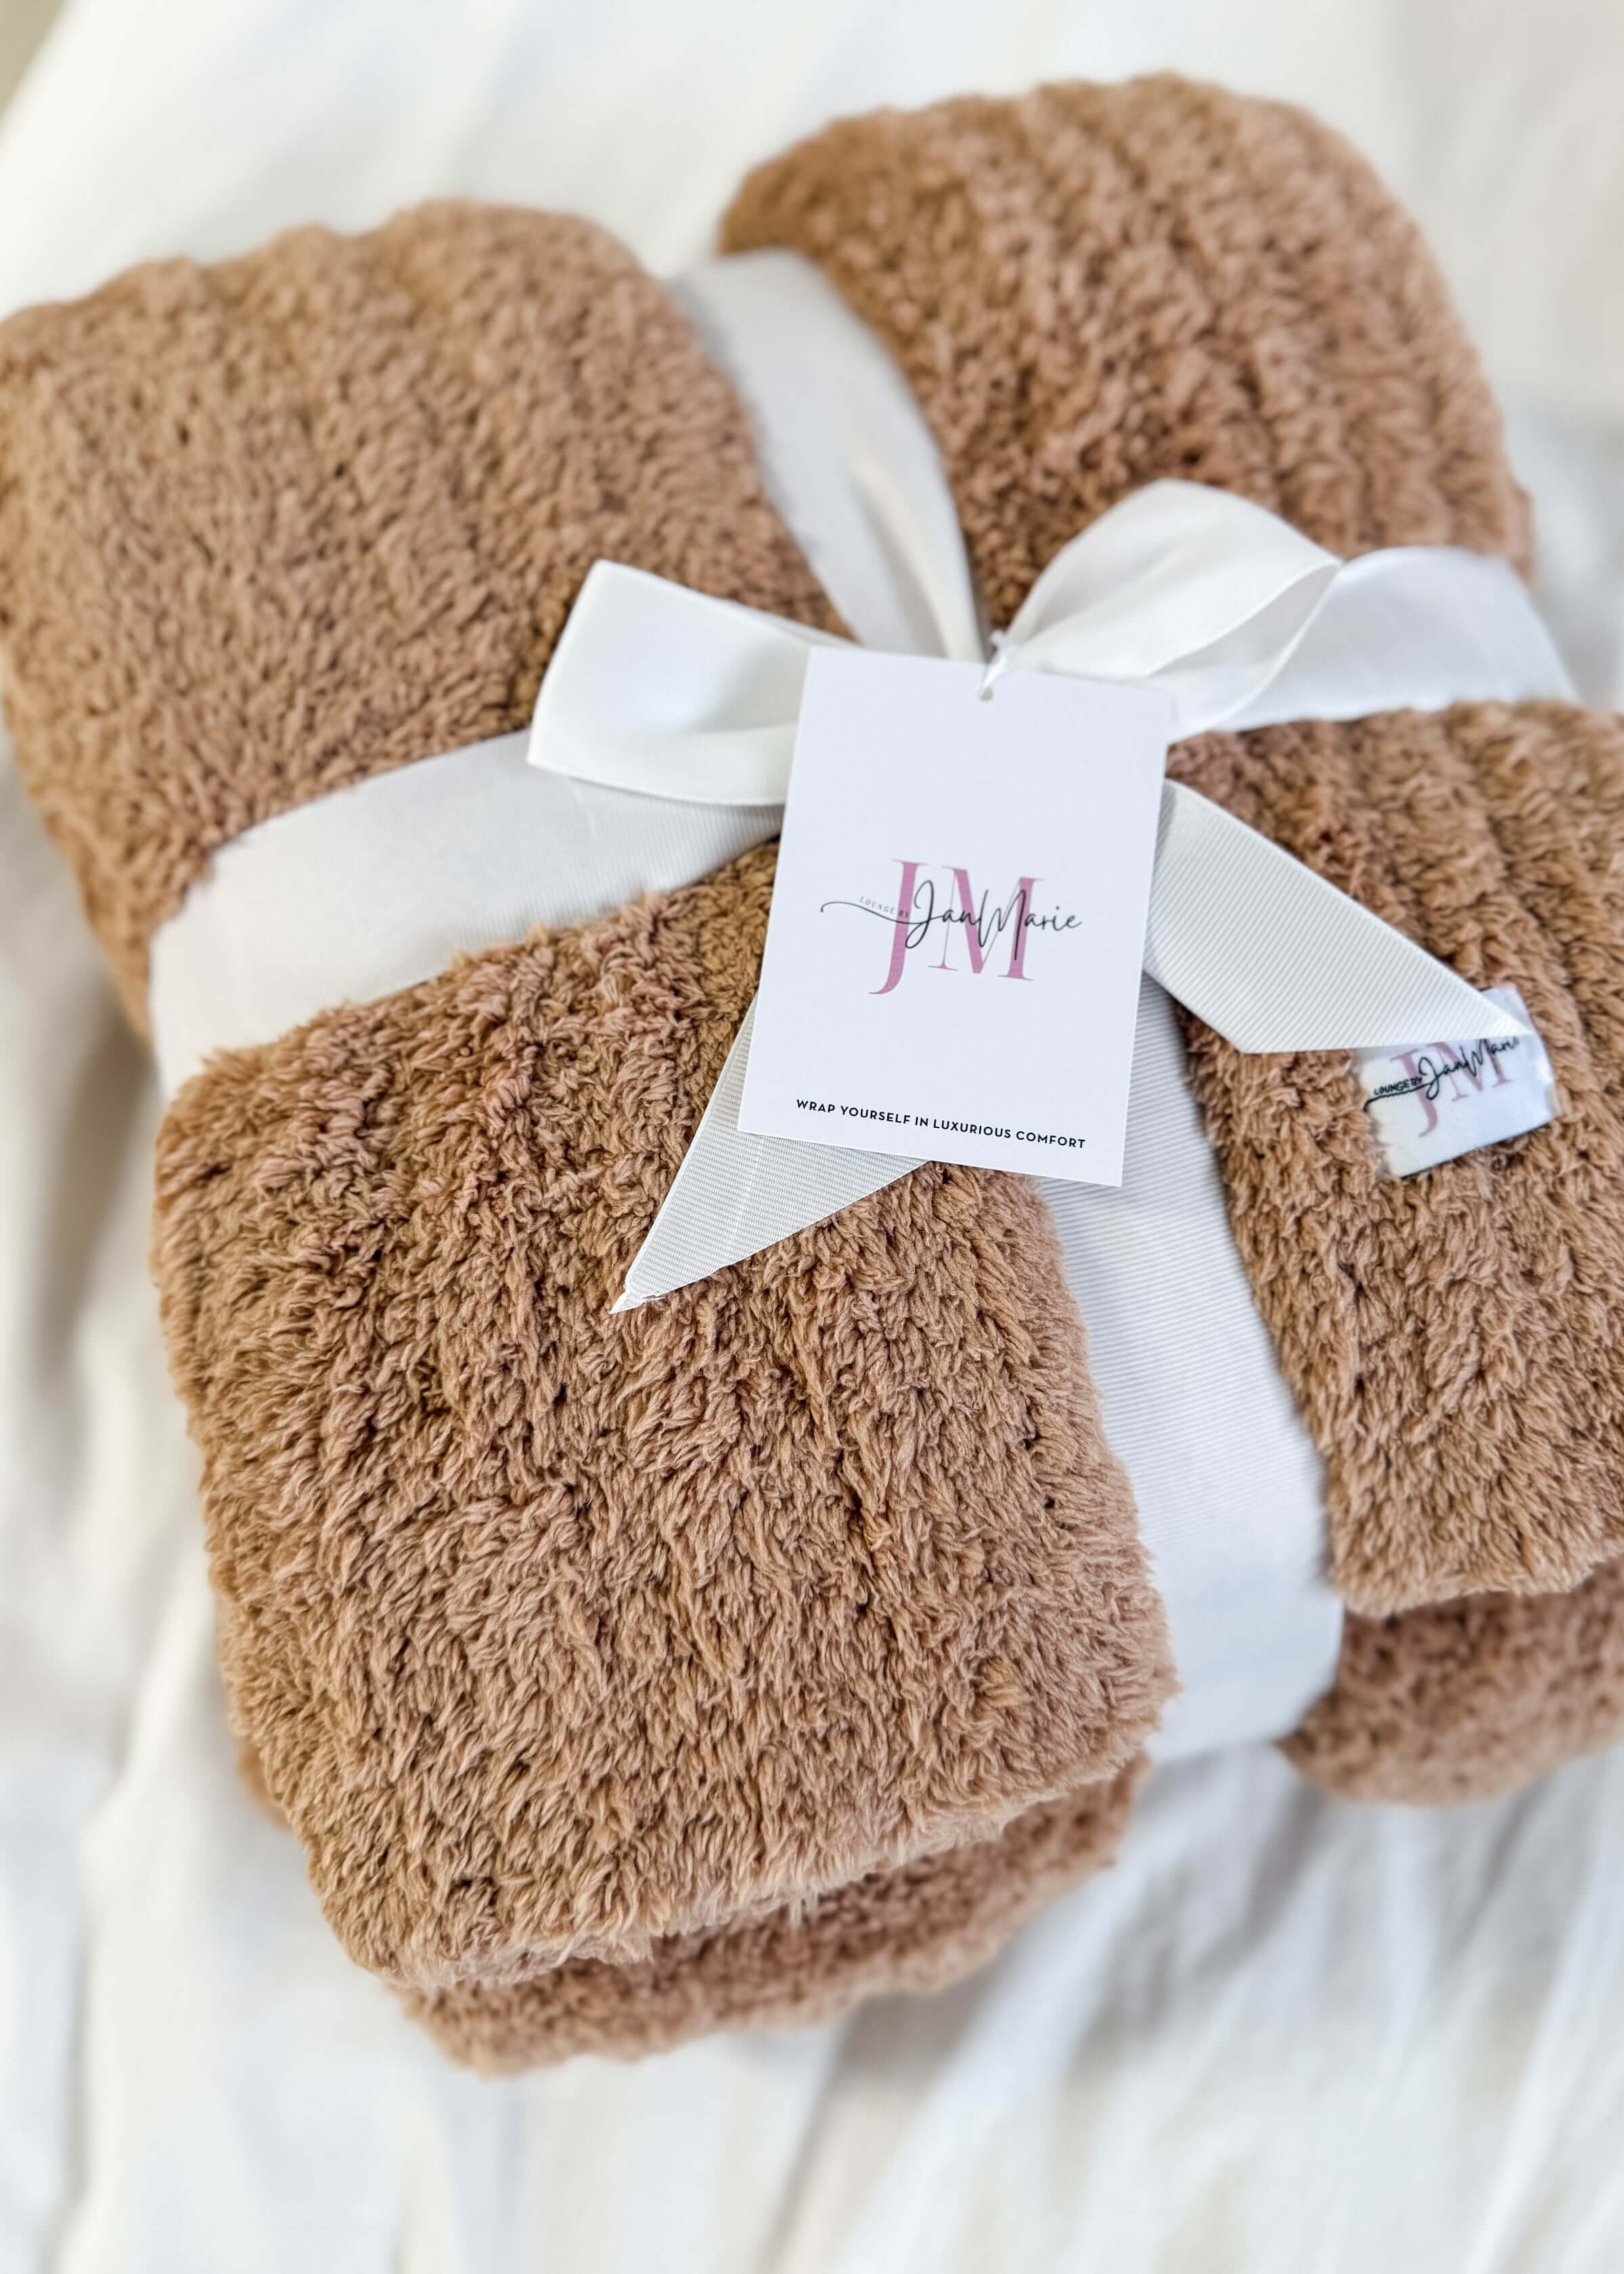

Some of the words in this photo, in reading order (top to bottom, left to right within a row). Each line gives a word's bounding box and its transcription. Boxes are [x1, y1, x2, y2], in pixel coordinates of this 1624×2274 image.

[859, 895, 895, 915] LOUNGE
[898, 910, 910, 918] BY
[867, 859, 1045, 995] JM
[1373, 1079, 1410, 1096] LOUNGE
[1409, 1076, 1422, 1086] BY
[796, 1098, 836, 1114] WRAP
[840, 1105, 911, 1125] YOURSELF
[914, 1116, 929, 1128] IN
[932, 1118, 1012, 1139] LUXURIOUS
[1015, 1130, 1086, 1149] COMFORT
